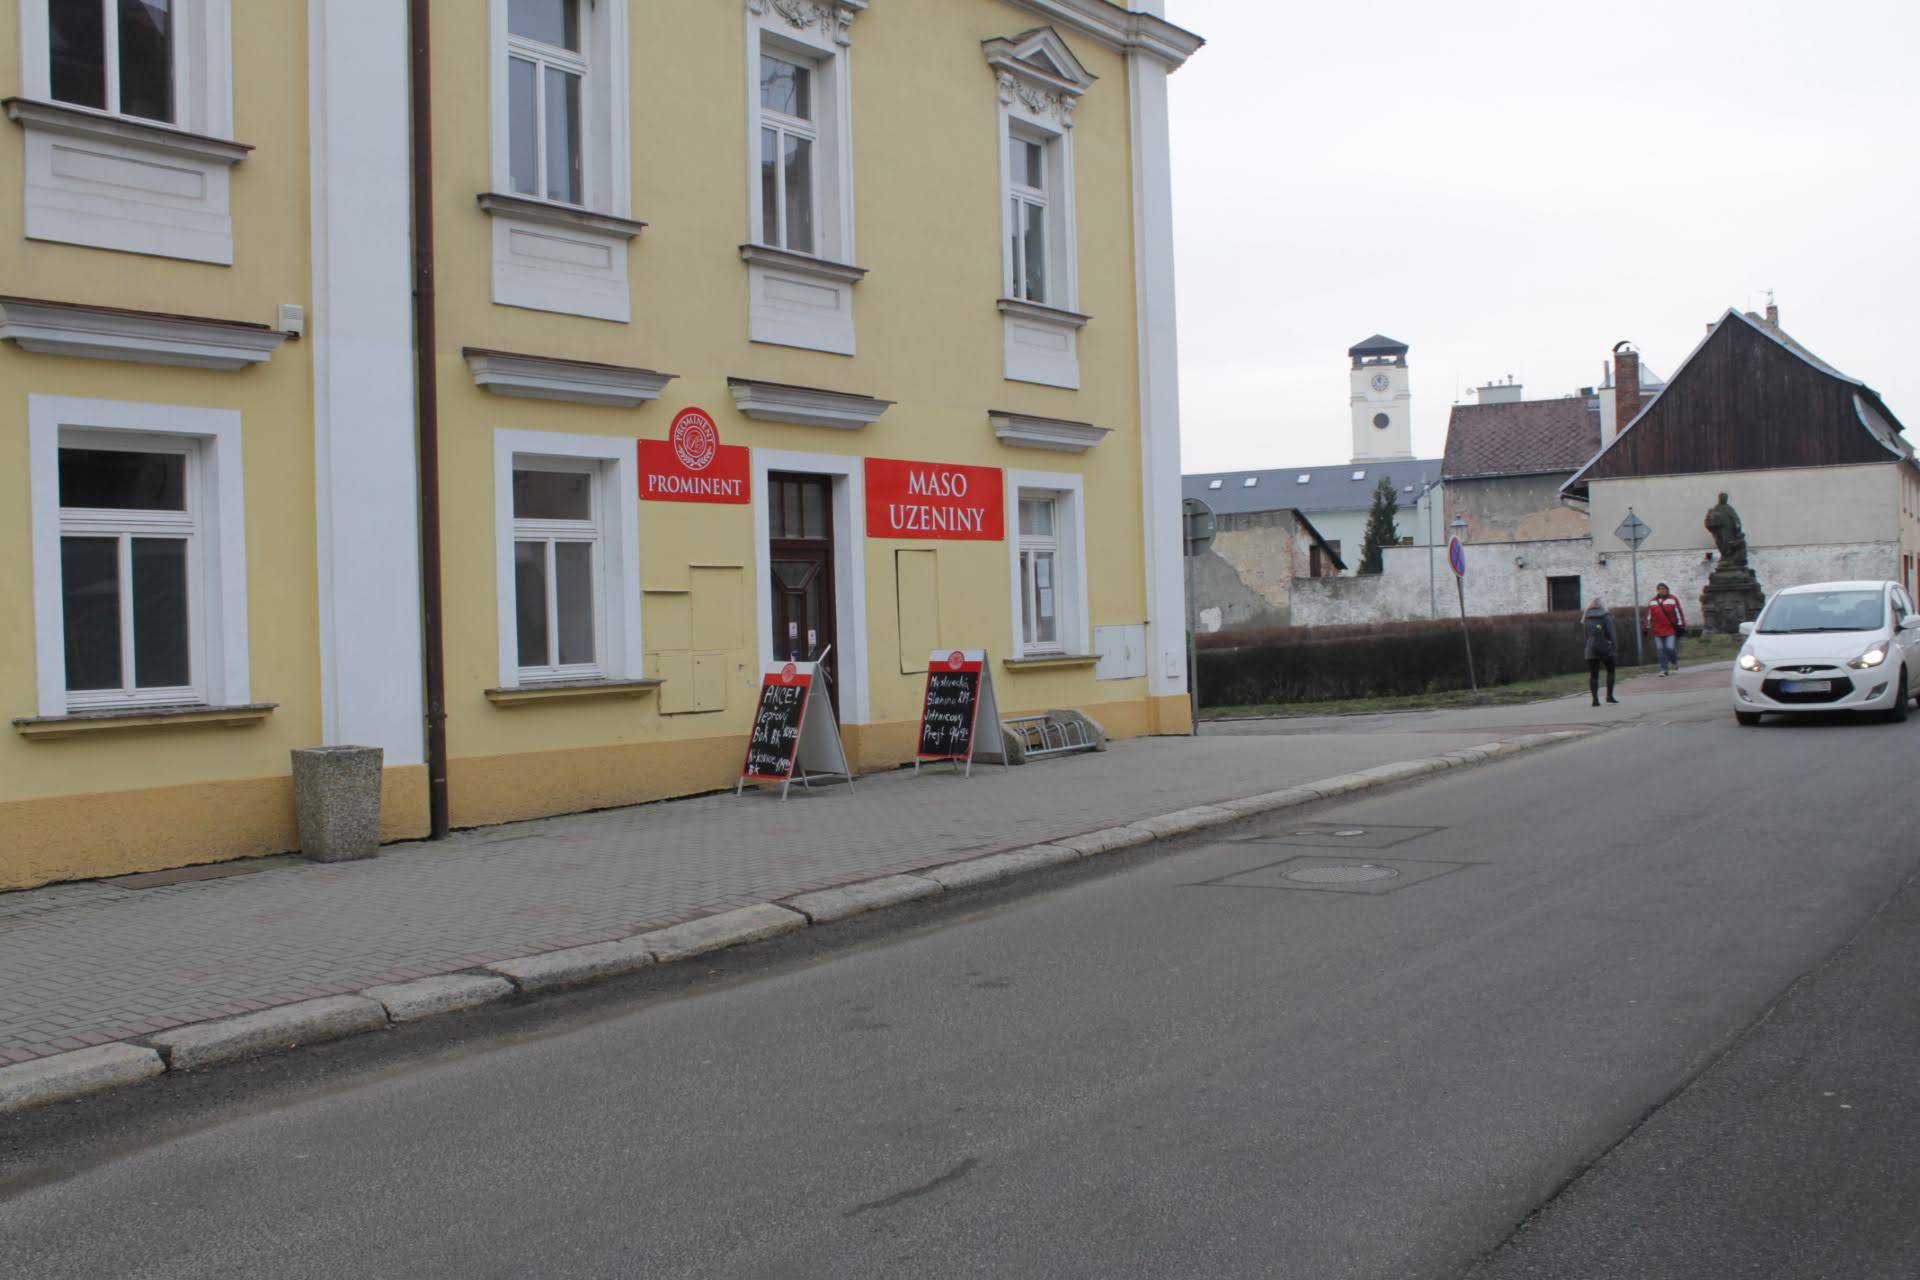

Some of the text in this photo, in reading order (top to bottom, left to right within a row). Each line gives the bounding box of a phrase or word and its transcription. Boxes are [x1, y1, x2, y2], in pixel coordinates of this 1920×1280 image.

[676, 415, 714, 441] PROMINENT
[648, 474, 742, 496] PROMINENT
[908, 470, 968, 498] MASO
[889, 504, 985, 532] UZENINY
[764, 685, 801, 704] AKCE!
